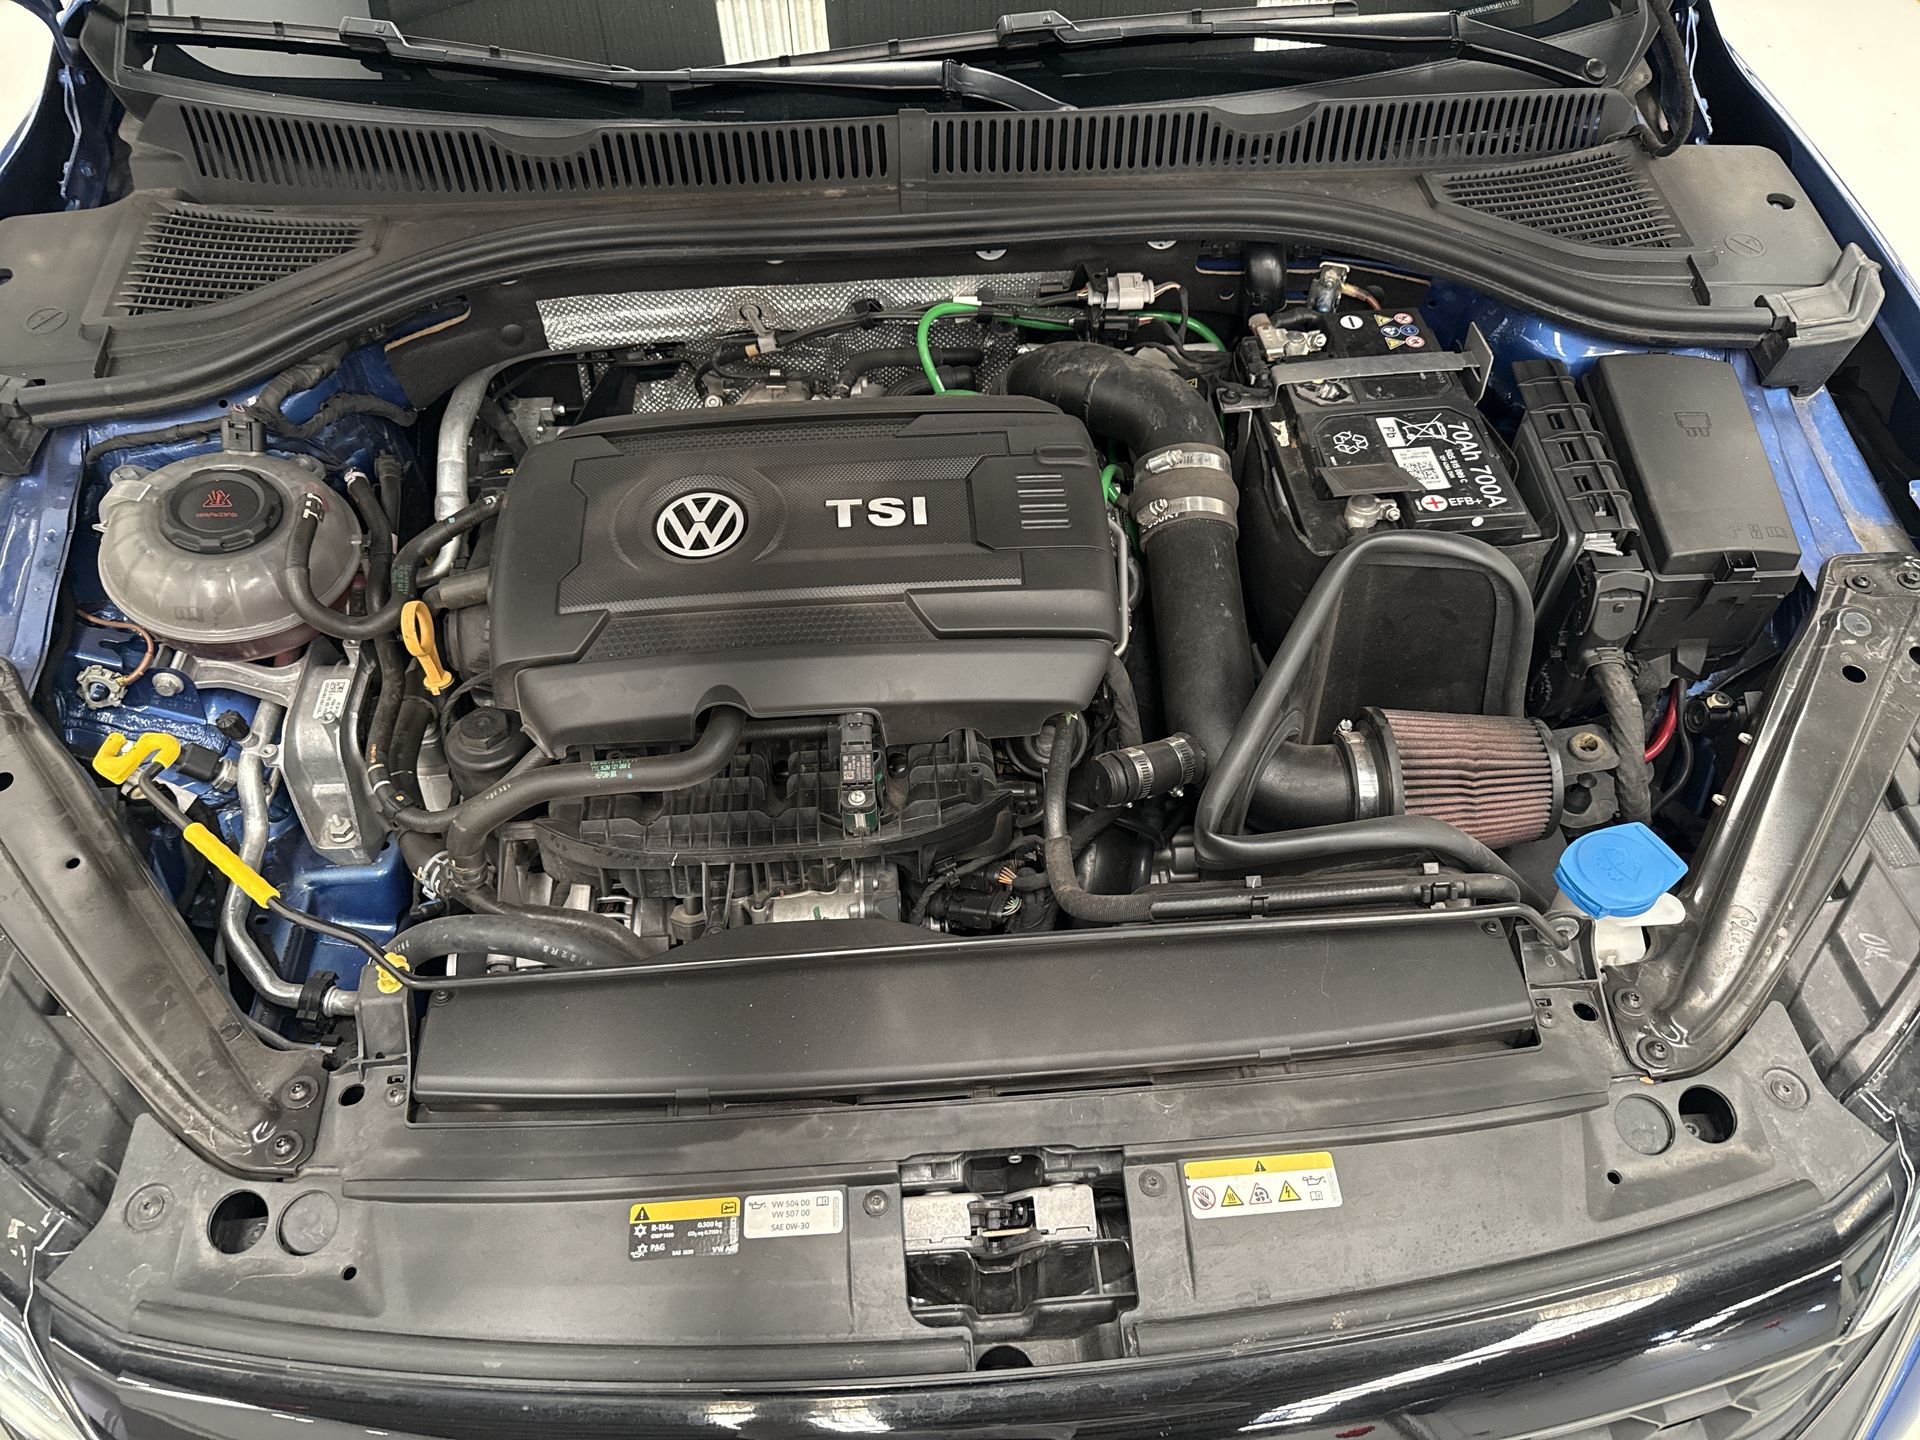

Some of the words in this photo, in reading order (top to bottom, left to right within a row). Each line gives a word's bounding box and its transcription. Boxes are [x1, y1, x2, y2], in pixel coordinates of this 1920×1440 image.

[1383, 426, 1397, 439] Pb
[1448, 421, 1482, 462] 70Ah
[1470, 464, 1507, 508] 700A
[1448, 496, 1483, 507] EFB+
[825, 496, 928, 529] TSI
[656, 491, 746, 558] VW
[772, 1200, 784, 1208] VW
[772, 1210, 784, 1218] VW
[651, 1223, 674, 1232] R-134a
[715, 1220, 723, 1228] kg
[771, 1223, 784, 1231] SAE
[785, 1222, 810, 1230] 0W-30
[650, 1243, 665, 1252] PAG
